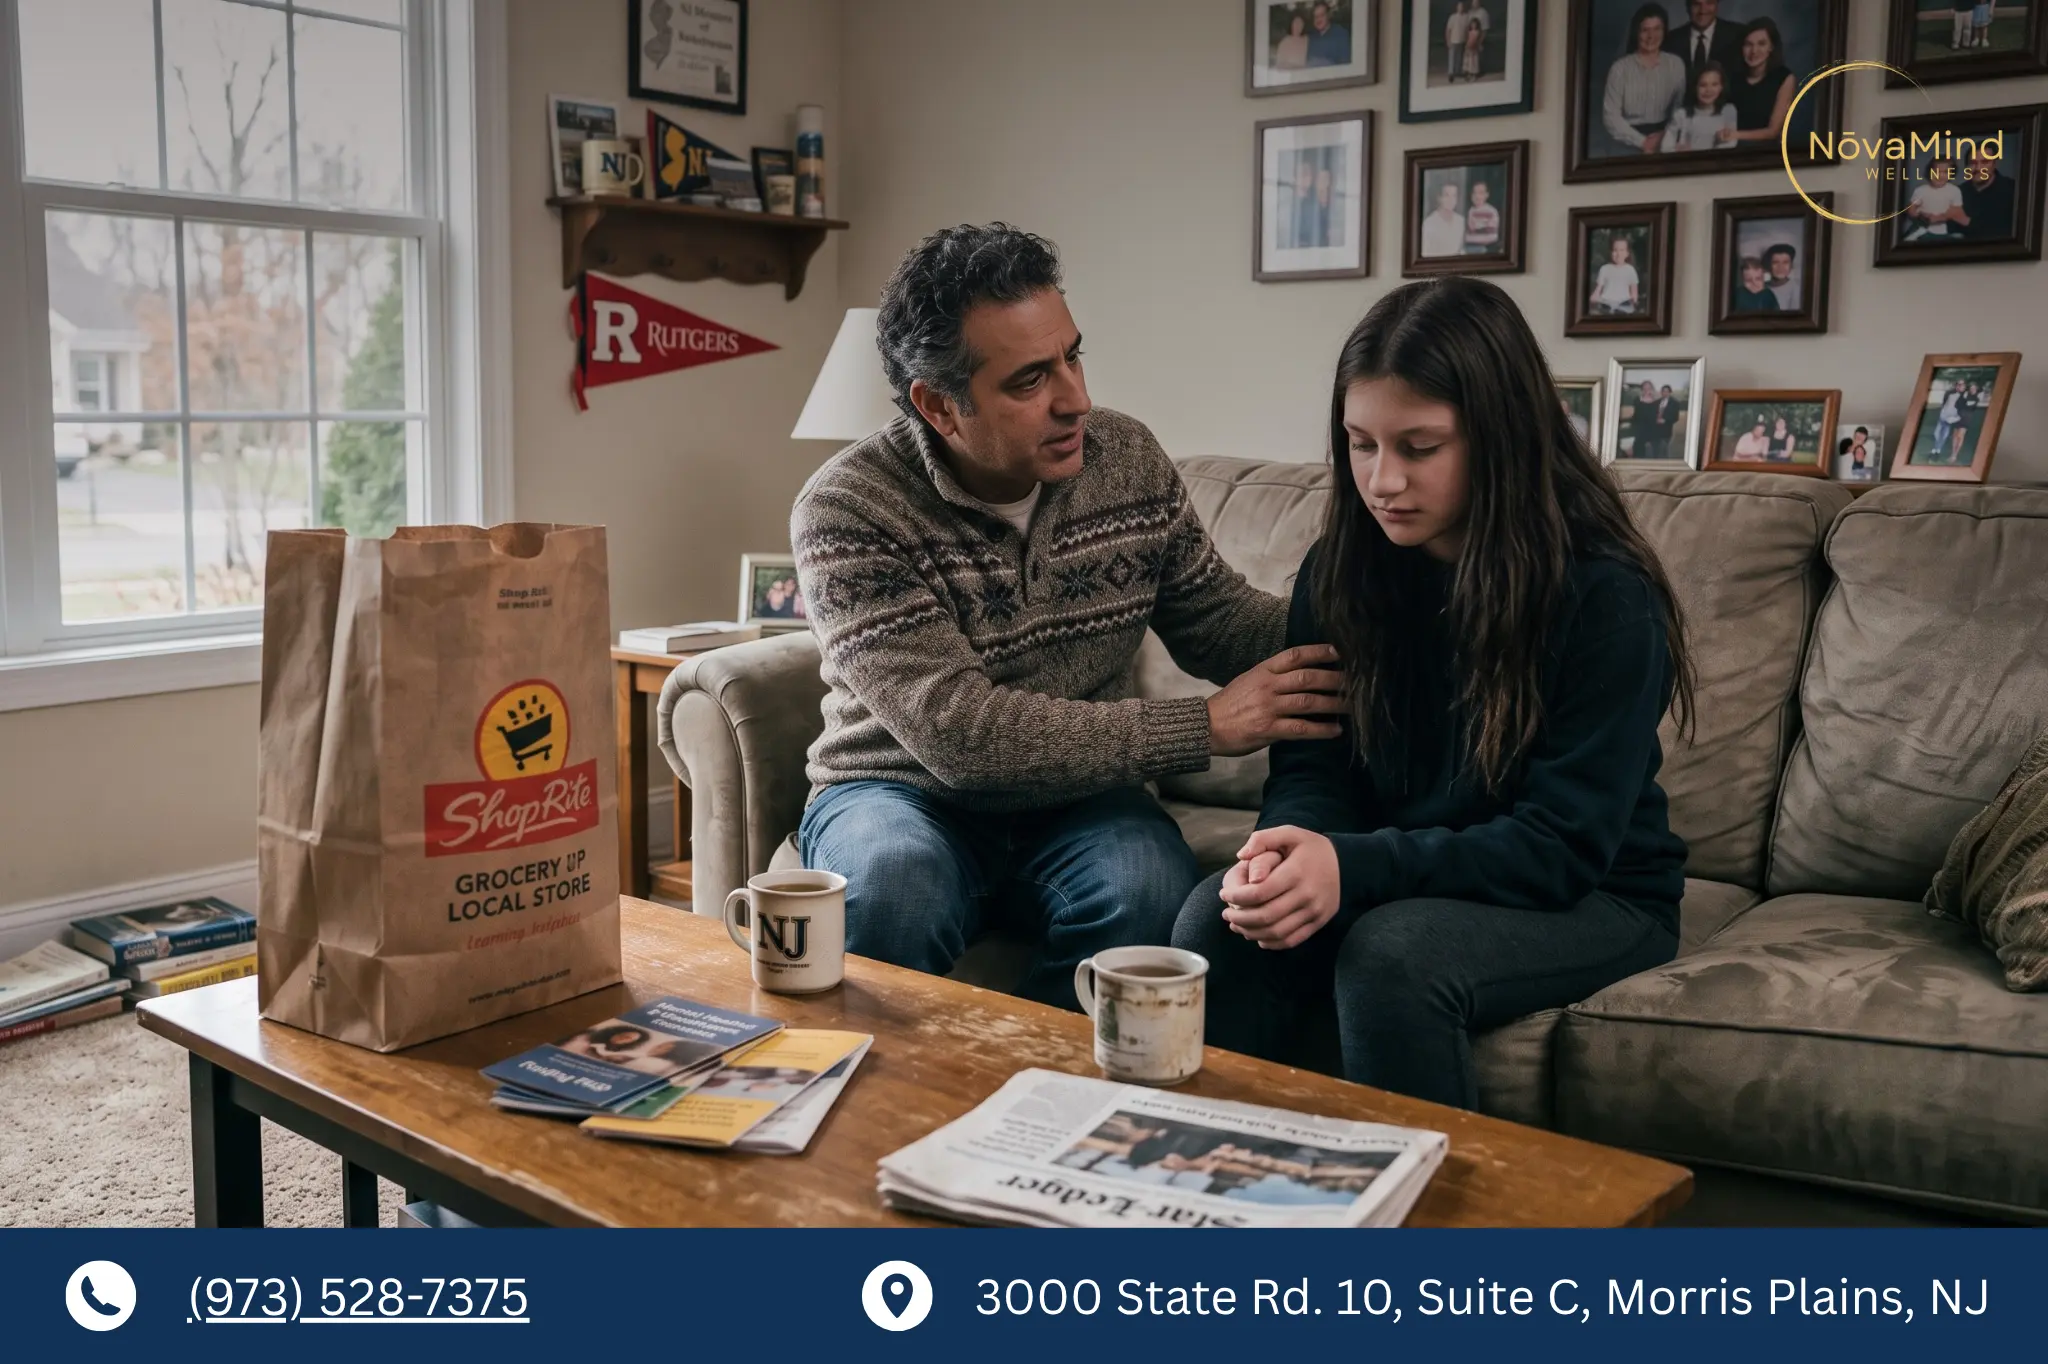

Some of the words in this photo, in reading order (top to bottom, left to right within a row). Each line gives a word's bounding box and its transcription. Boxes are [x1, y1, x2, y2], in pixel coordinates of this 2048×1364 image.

[601, 152, 626, 181] NJ
[592, 300, 642, 363] R
[648, 321, 739, 357] RUTGERS
[439, 772, 592, 848] ShopRite
[456, 857, 561, 894] GROCERY
[566, 849, 586, 873] UP
[448, 894, 526, 922] LOCAL
[533, 873, 590, 907] STORE
[758, 911, 811, 961] NJ
